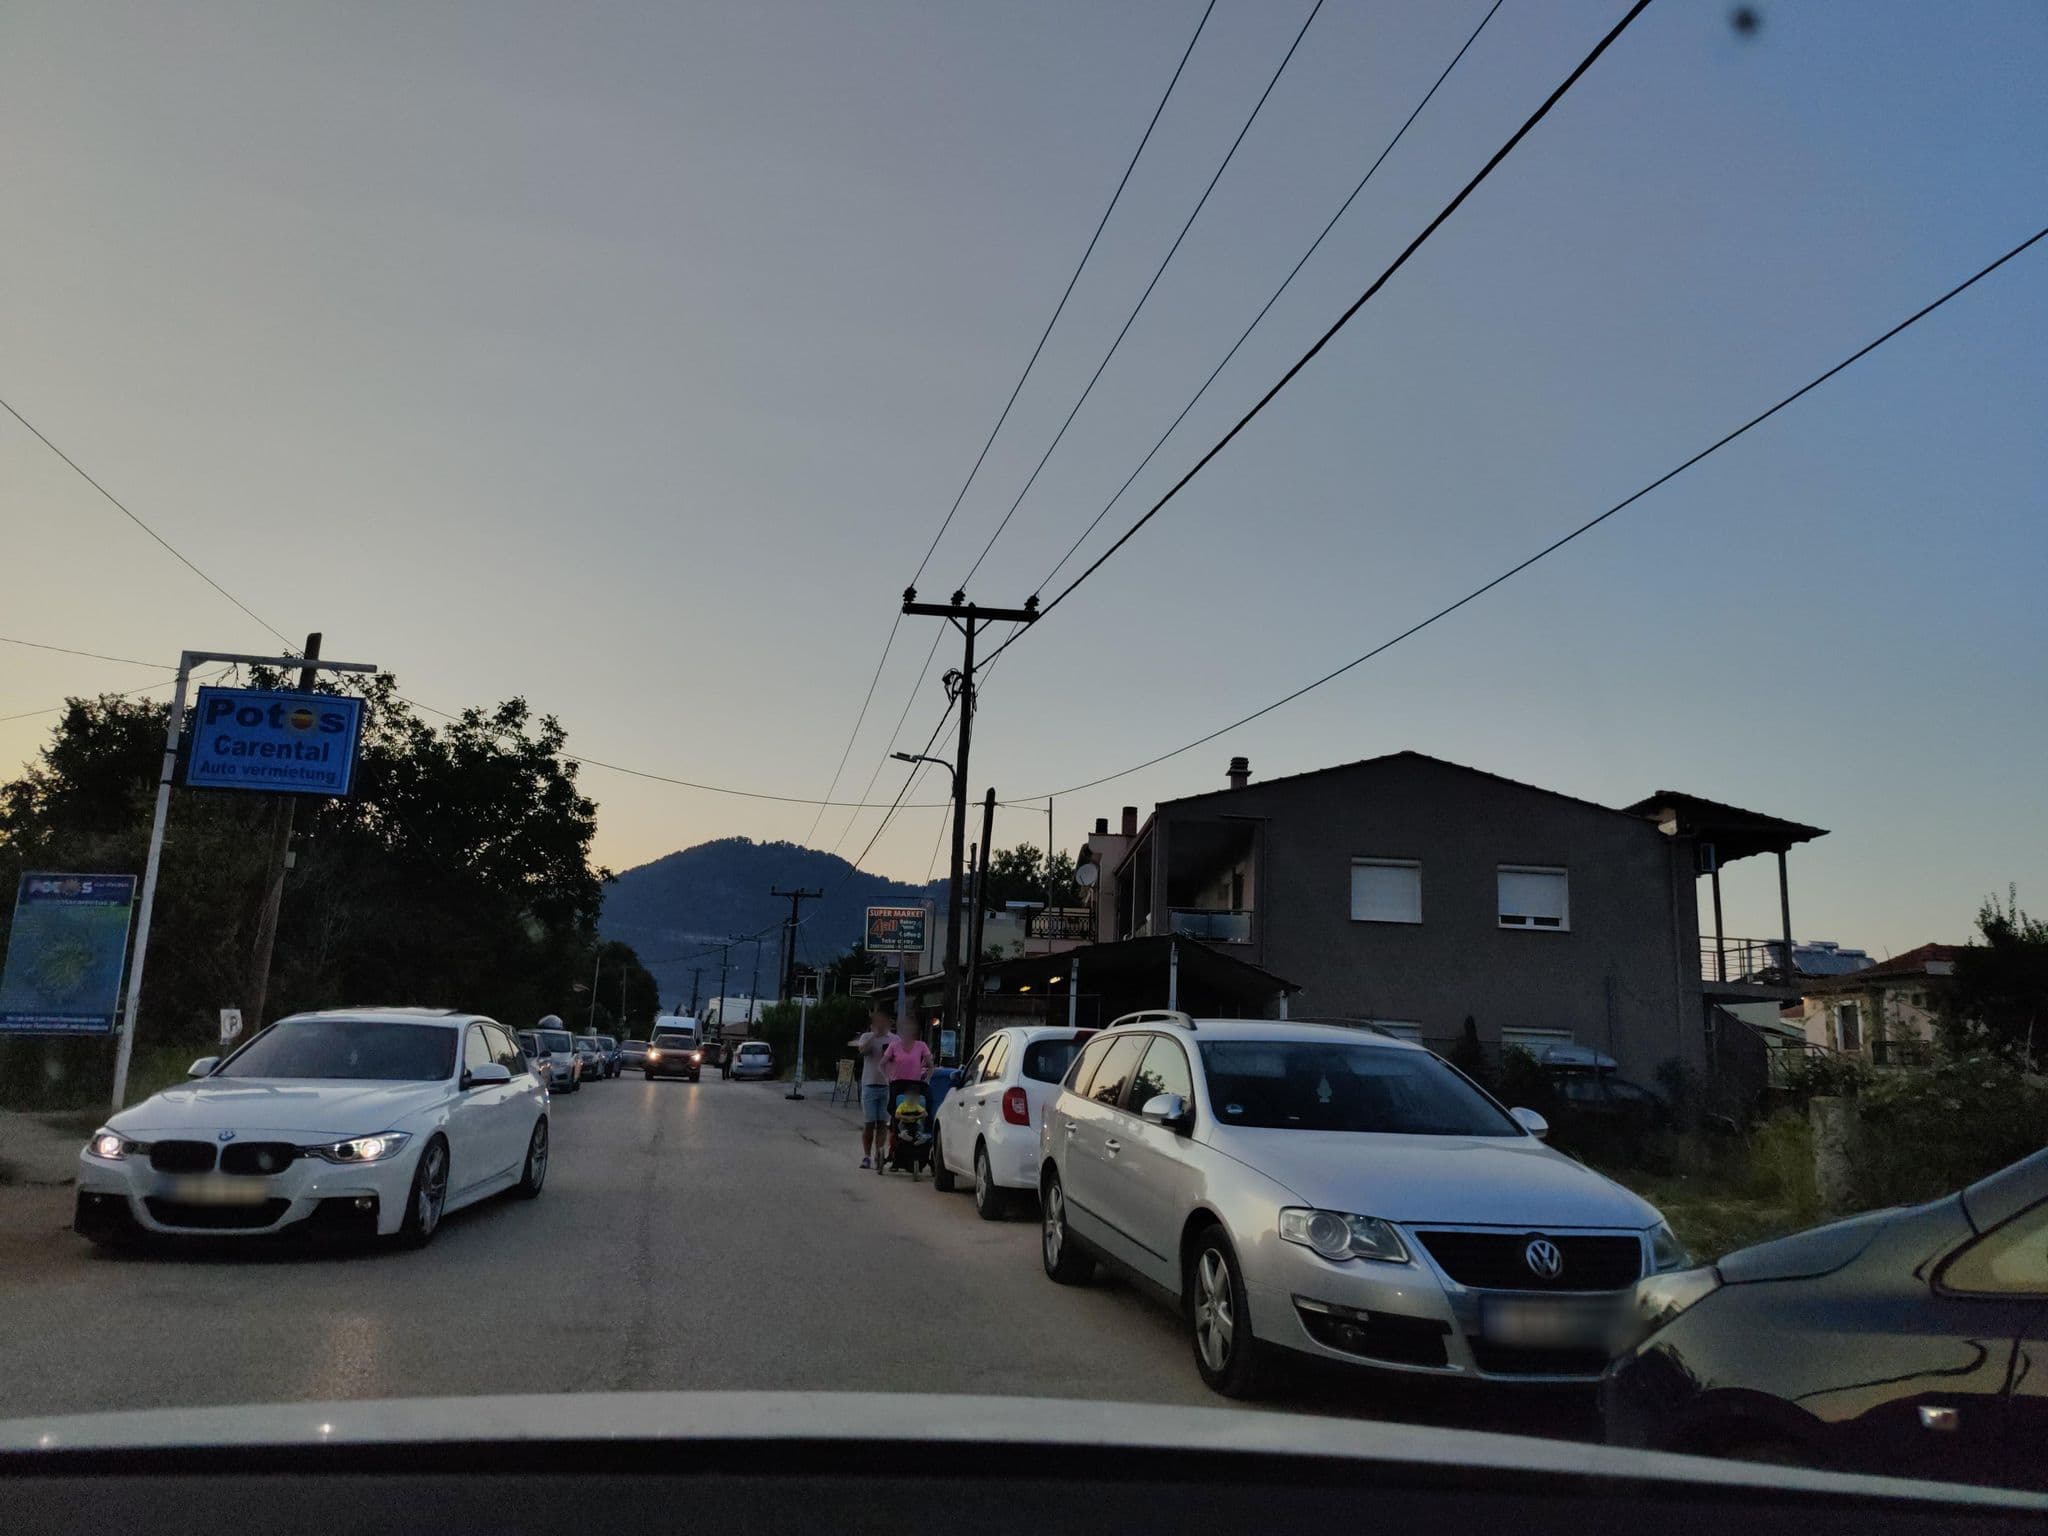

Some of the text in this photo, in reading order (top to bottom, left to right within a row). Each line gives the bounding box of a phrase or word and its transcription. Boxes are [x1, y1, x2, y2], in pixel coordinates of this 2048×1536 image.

[213, 734, 330, 763] Carental
[200, 760, 338, 786] Auto vermietung
[893, 910, 923, 918] MARKET
